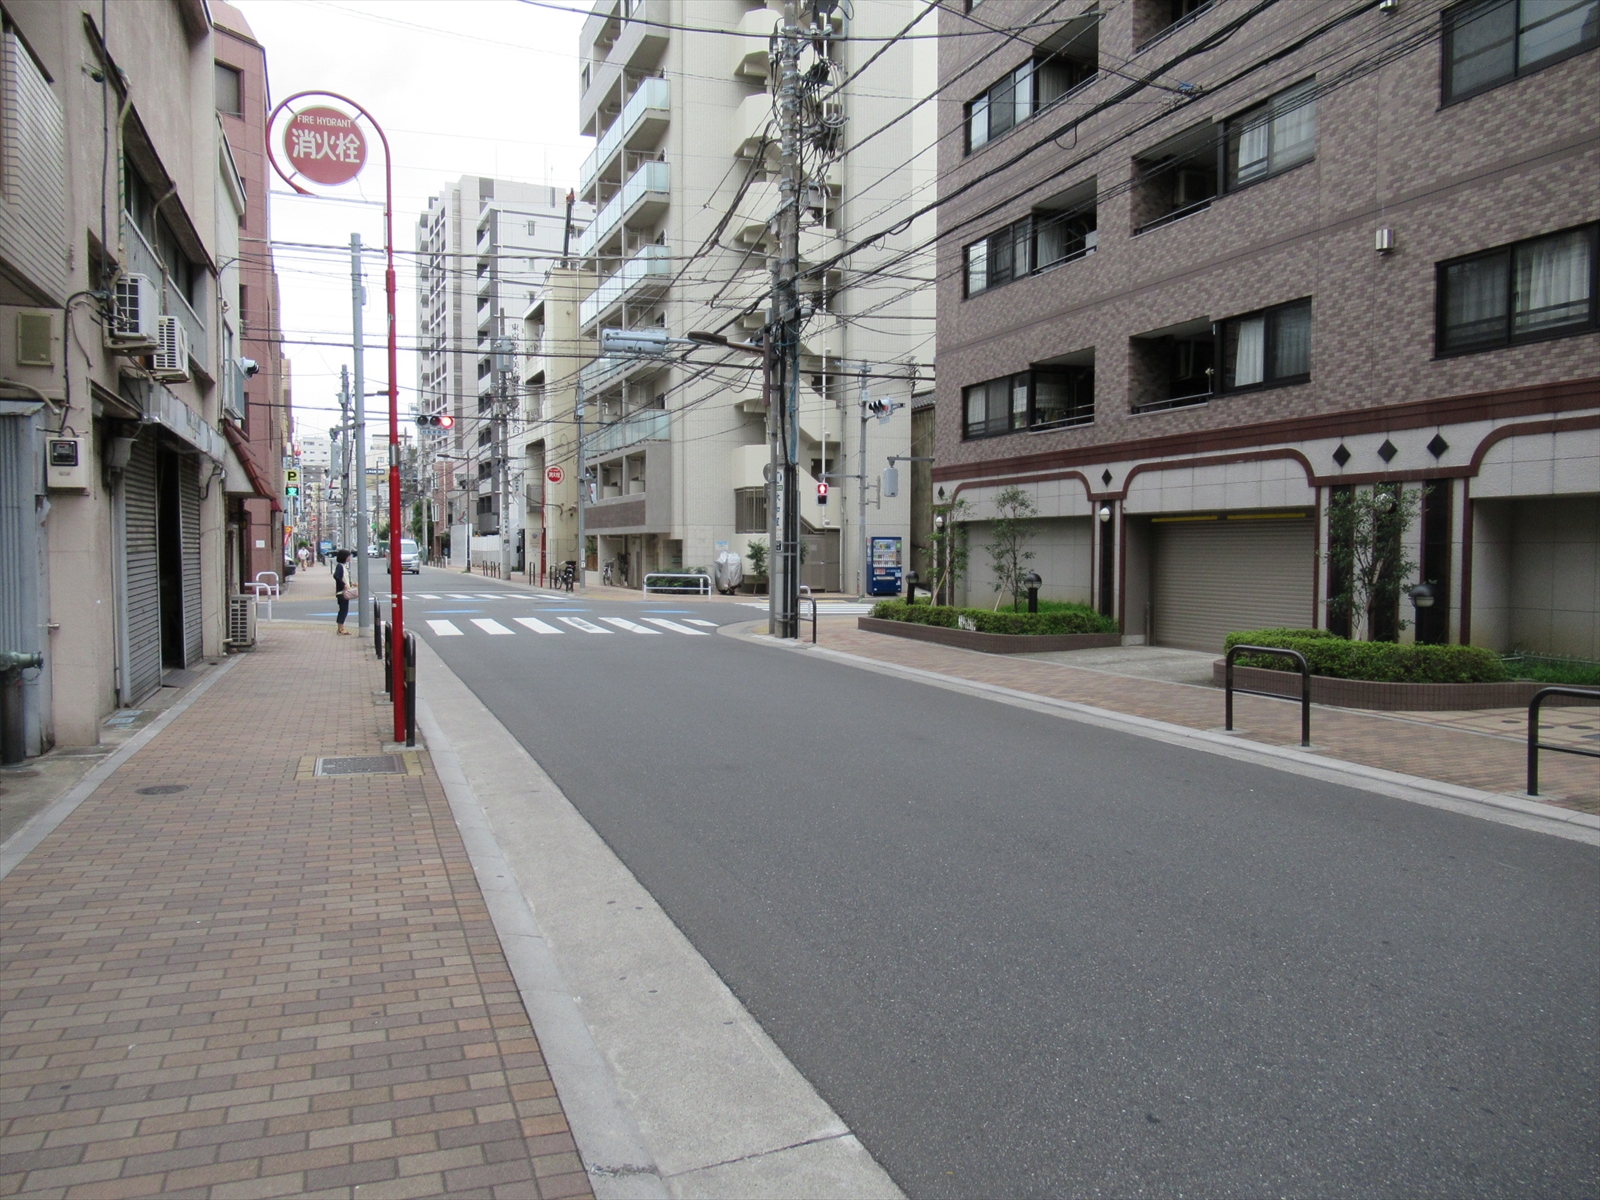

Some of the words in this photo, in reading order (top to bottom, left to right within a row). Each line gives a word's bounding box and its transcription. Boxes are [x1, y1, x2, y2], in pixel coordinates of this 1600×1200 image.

[297, 115, 314, 125] FIRE
[316, 117, 352, 128] HYDRANT
[292, 128, 360, 163] 消火栓
[288, 471, 297, 481] P
